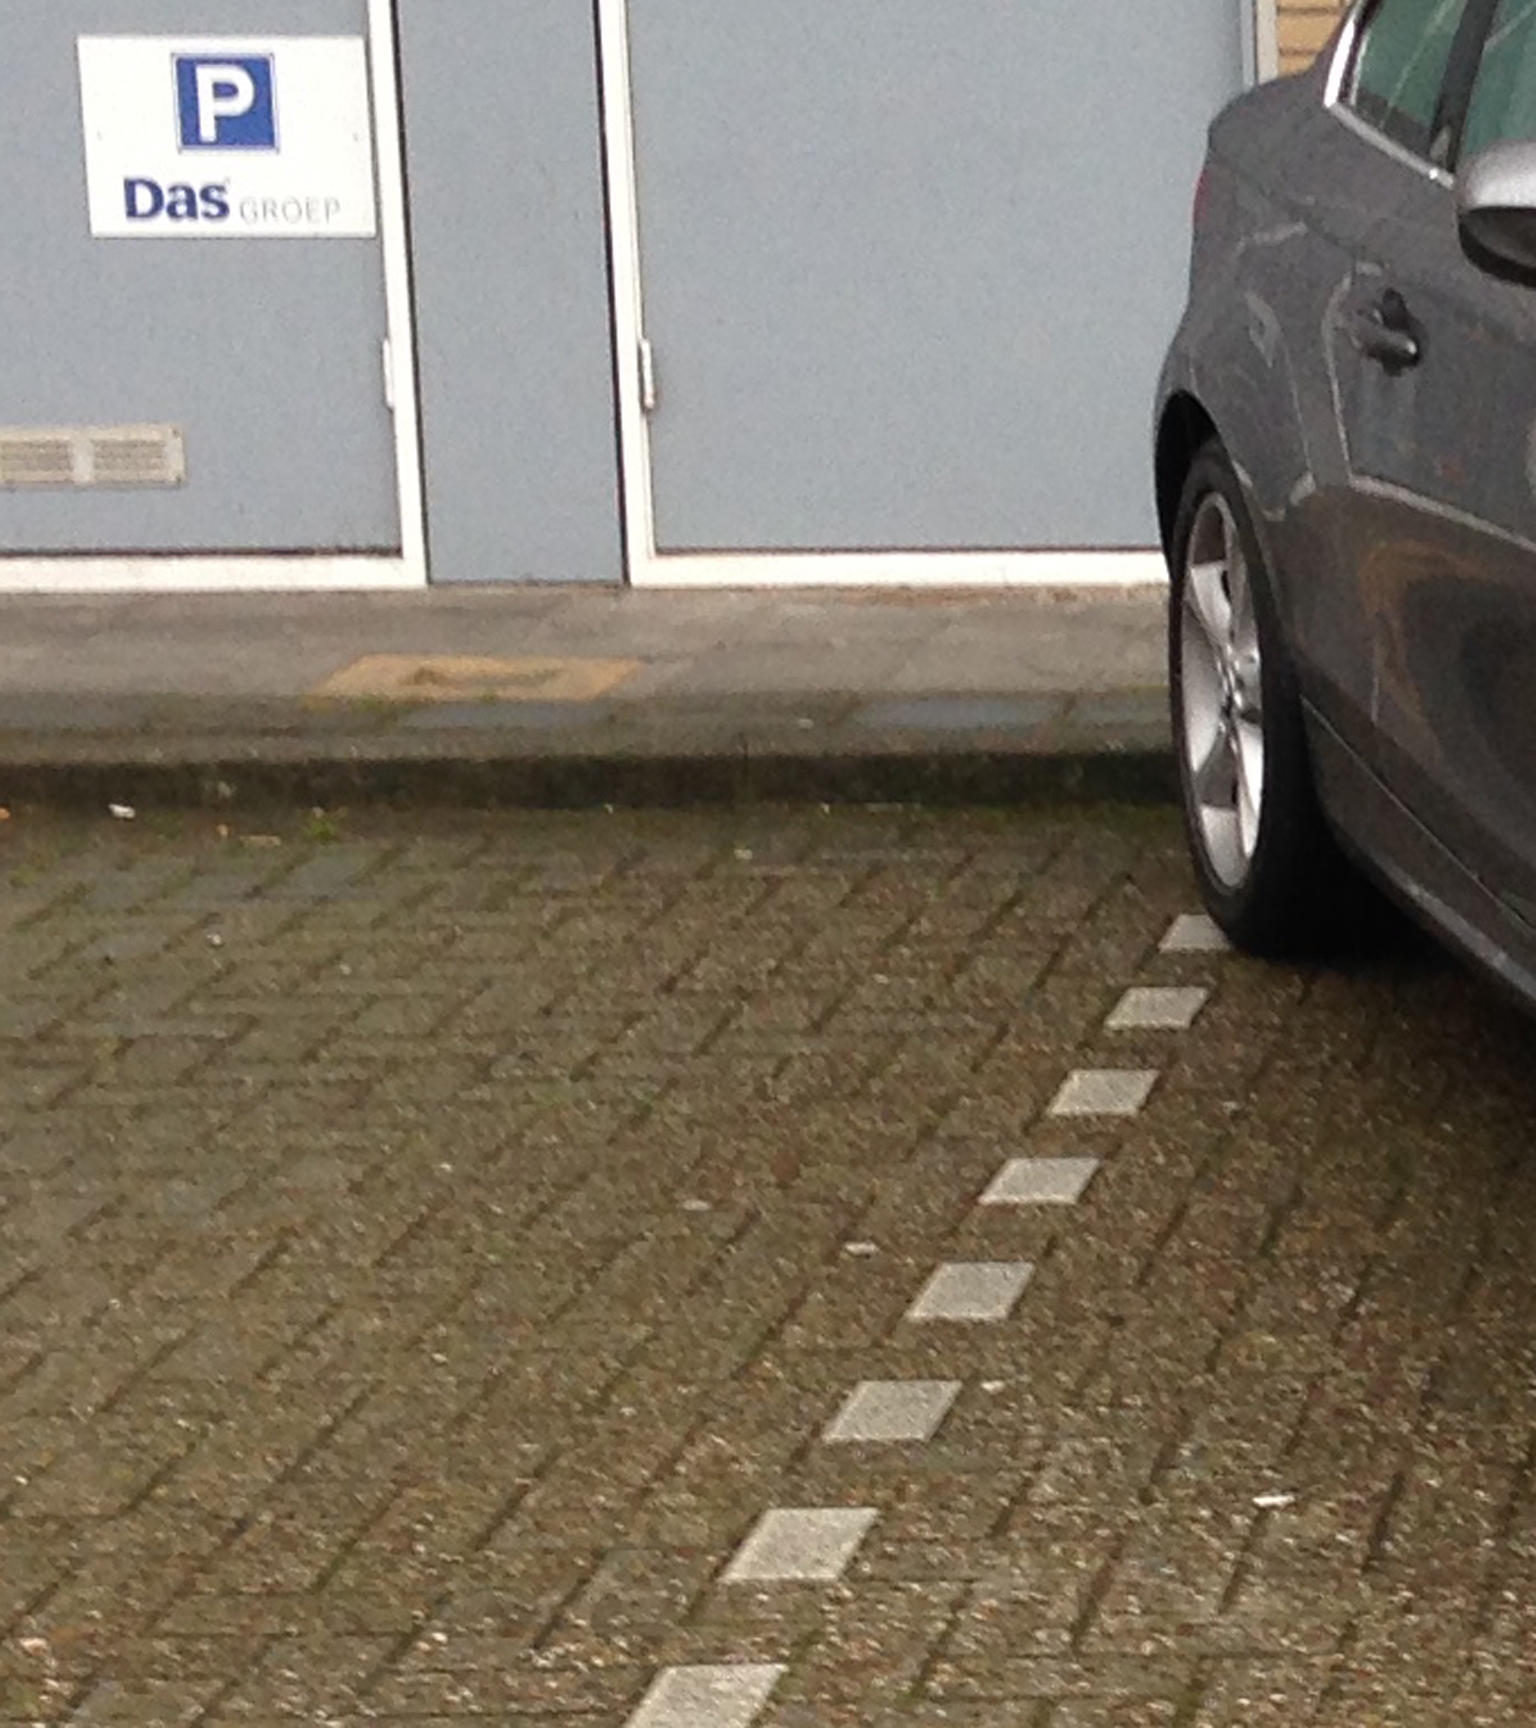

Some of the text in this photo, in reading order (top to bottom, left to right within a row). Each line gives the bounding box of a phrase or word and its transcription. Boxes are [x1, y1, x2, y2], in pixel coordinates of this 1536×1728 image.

[195, 63, 256, 143] P
[123, 176, 342, 225] Das GROEP
